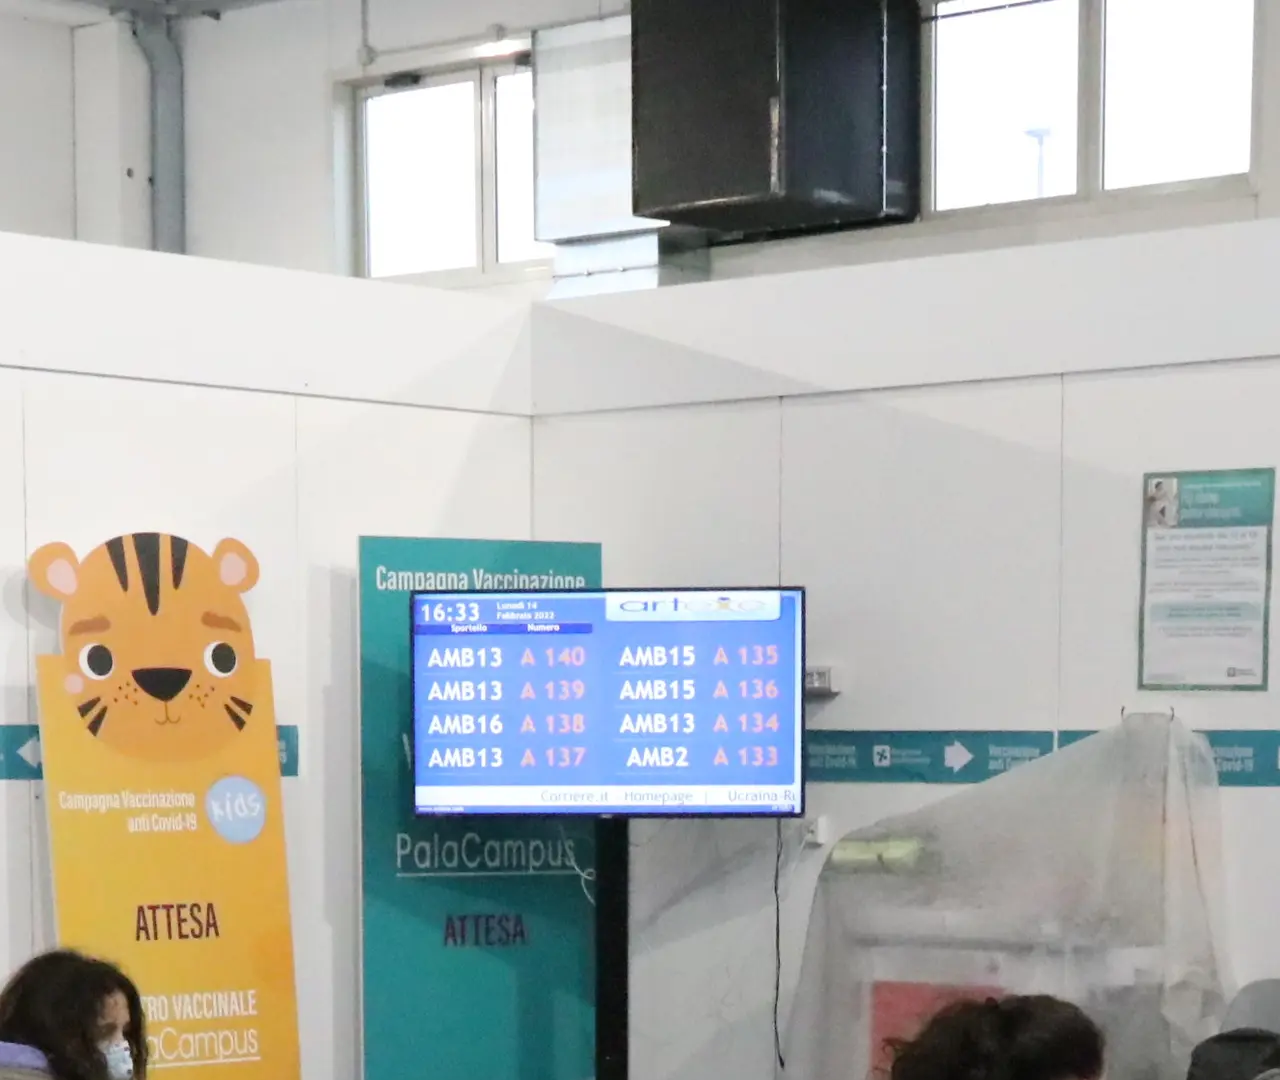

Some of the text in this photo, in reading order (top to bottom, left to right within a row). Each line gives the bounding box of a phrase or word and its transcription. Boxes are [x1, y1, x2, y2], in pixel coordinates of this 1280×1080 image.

[376, 565, 468, 590] Campagna
[421, 602, 480, 622] 16:33
[451, 624, 487, 633] Sportello
[527, 624, 560, 632] Numero
[428, 648, 586, 667] AMB13 A 140
[619, 646, 779, 666] AMB15 A 135
[428, 682, 586, 700] AMB13 A 139
[619, 679, 779, 699] AMB15 A 136
[428, 715, 586, 734] AMB16 A 138
[619, 712, 779, 732] AMB13 A 134
[428, 748, 586, 767] AMB13 A 137
[627, 747, 779, 767] AMB2 A 133
[58, 789, 195, 813] Campagna Vaccinazione
[625, 791, 693, 805] Homepage
[128, 813, 197, 833] anti Covid-19
[396, 832, 575, 872] PalaCampus
[135, 903, 219, 941] ATTESA
[444, 914, 527, 947] ATTESA
[141, 989, 257, 1021] TRO VACCINALE
[147, 1028, 258, 1060] aCampus
